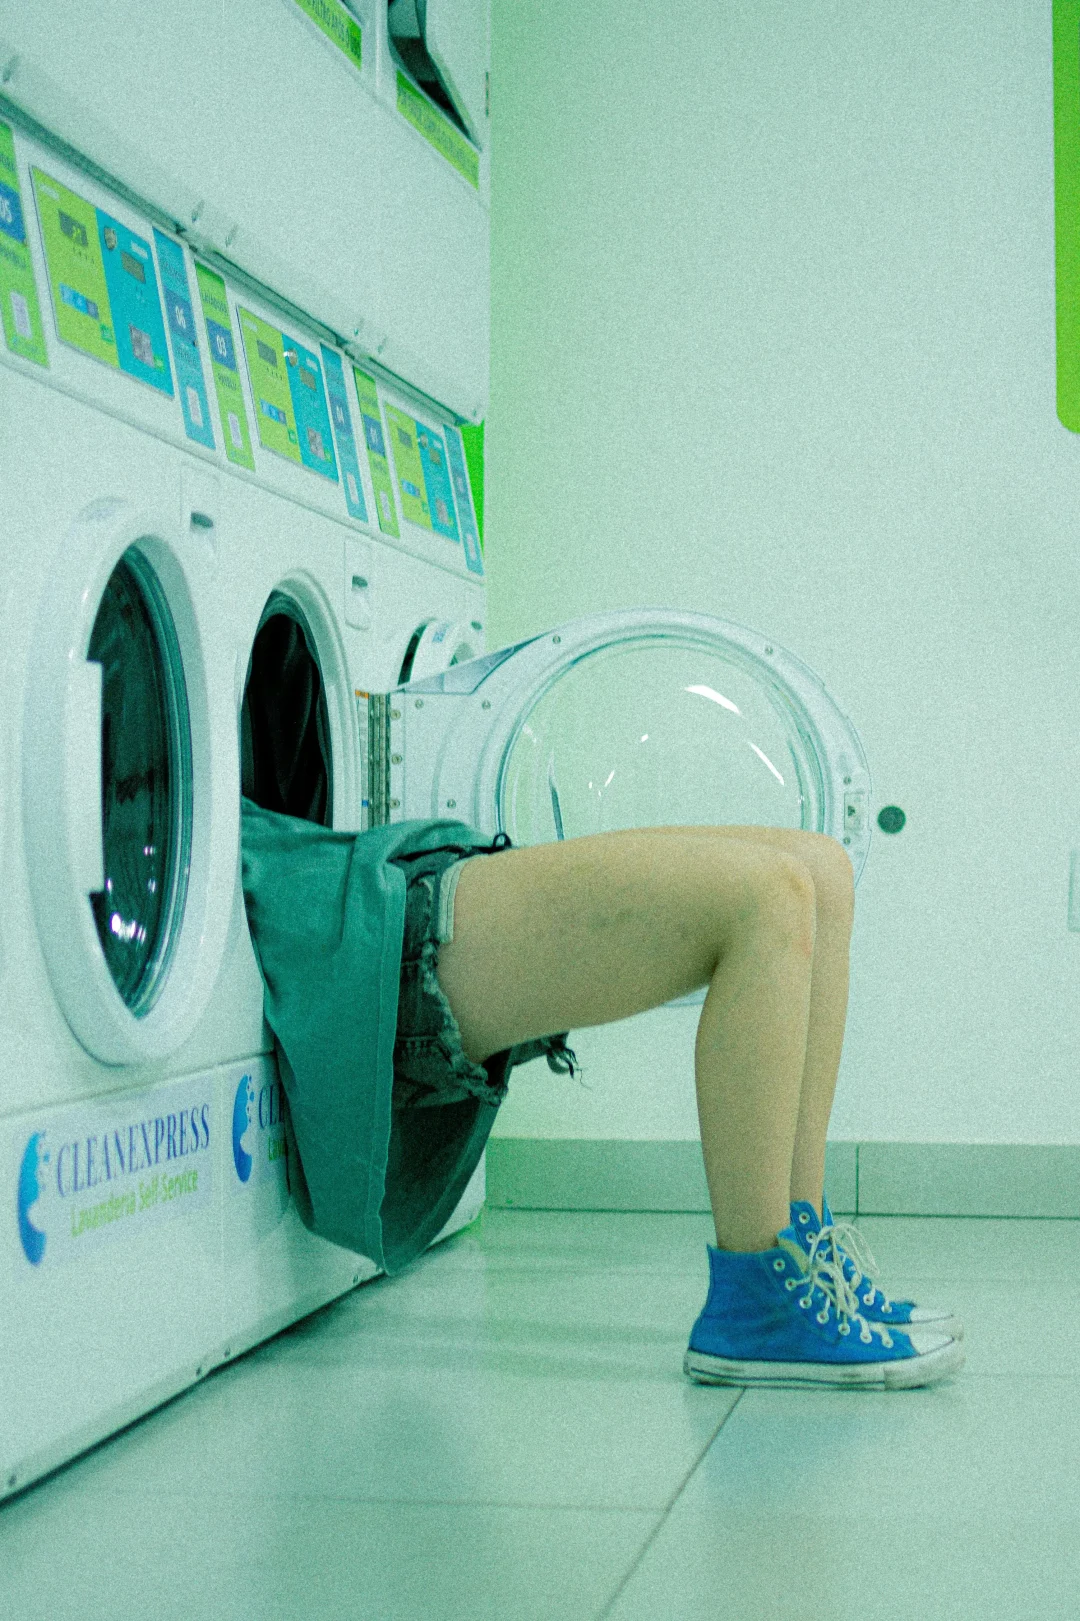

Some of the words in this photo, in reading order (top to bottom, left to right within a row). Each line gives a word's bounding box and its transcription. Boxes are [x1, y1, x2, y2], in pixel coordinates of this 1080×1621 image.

[216, 335, 228, 357] 03
[57, 1103, 210, 1198] CLEANEXPRESS
[139, 1173, 159, 1212] Self
[161, 1169, 198, 1203] Service
